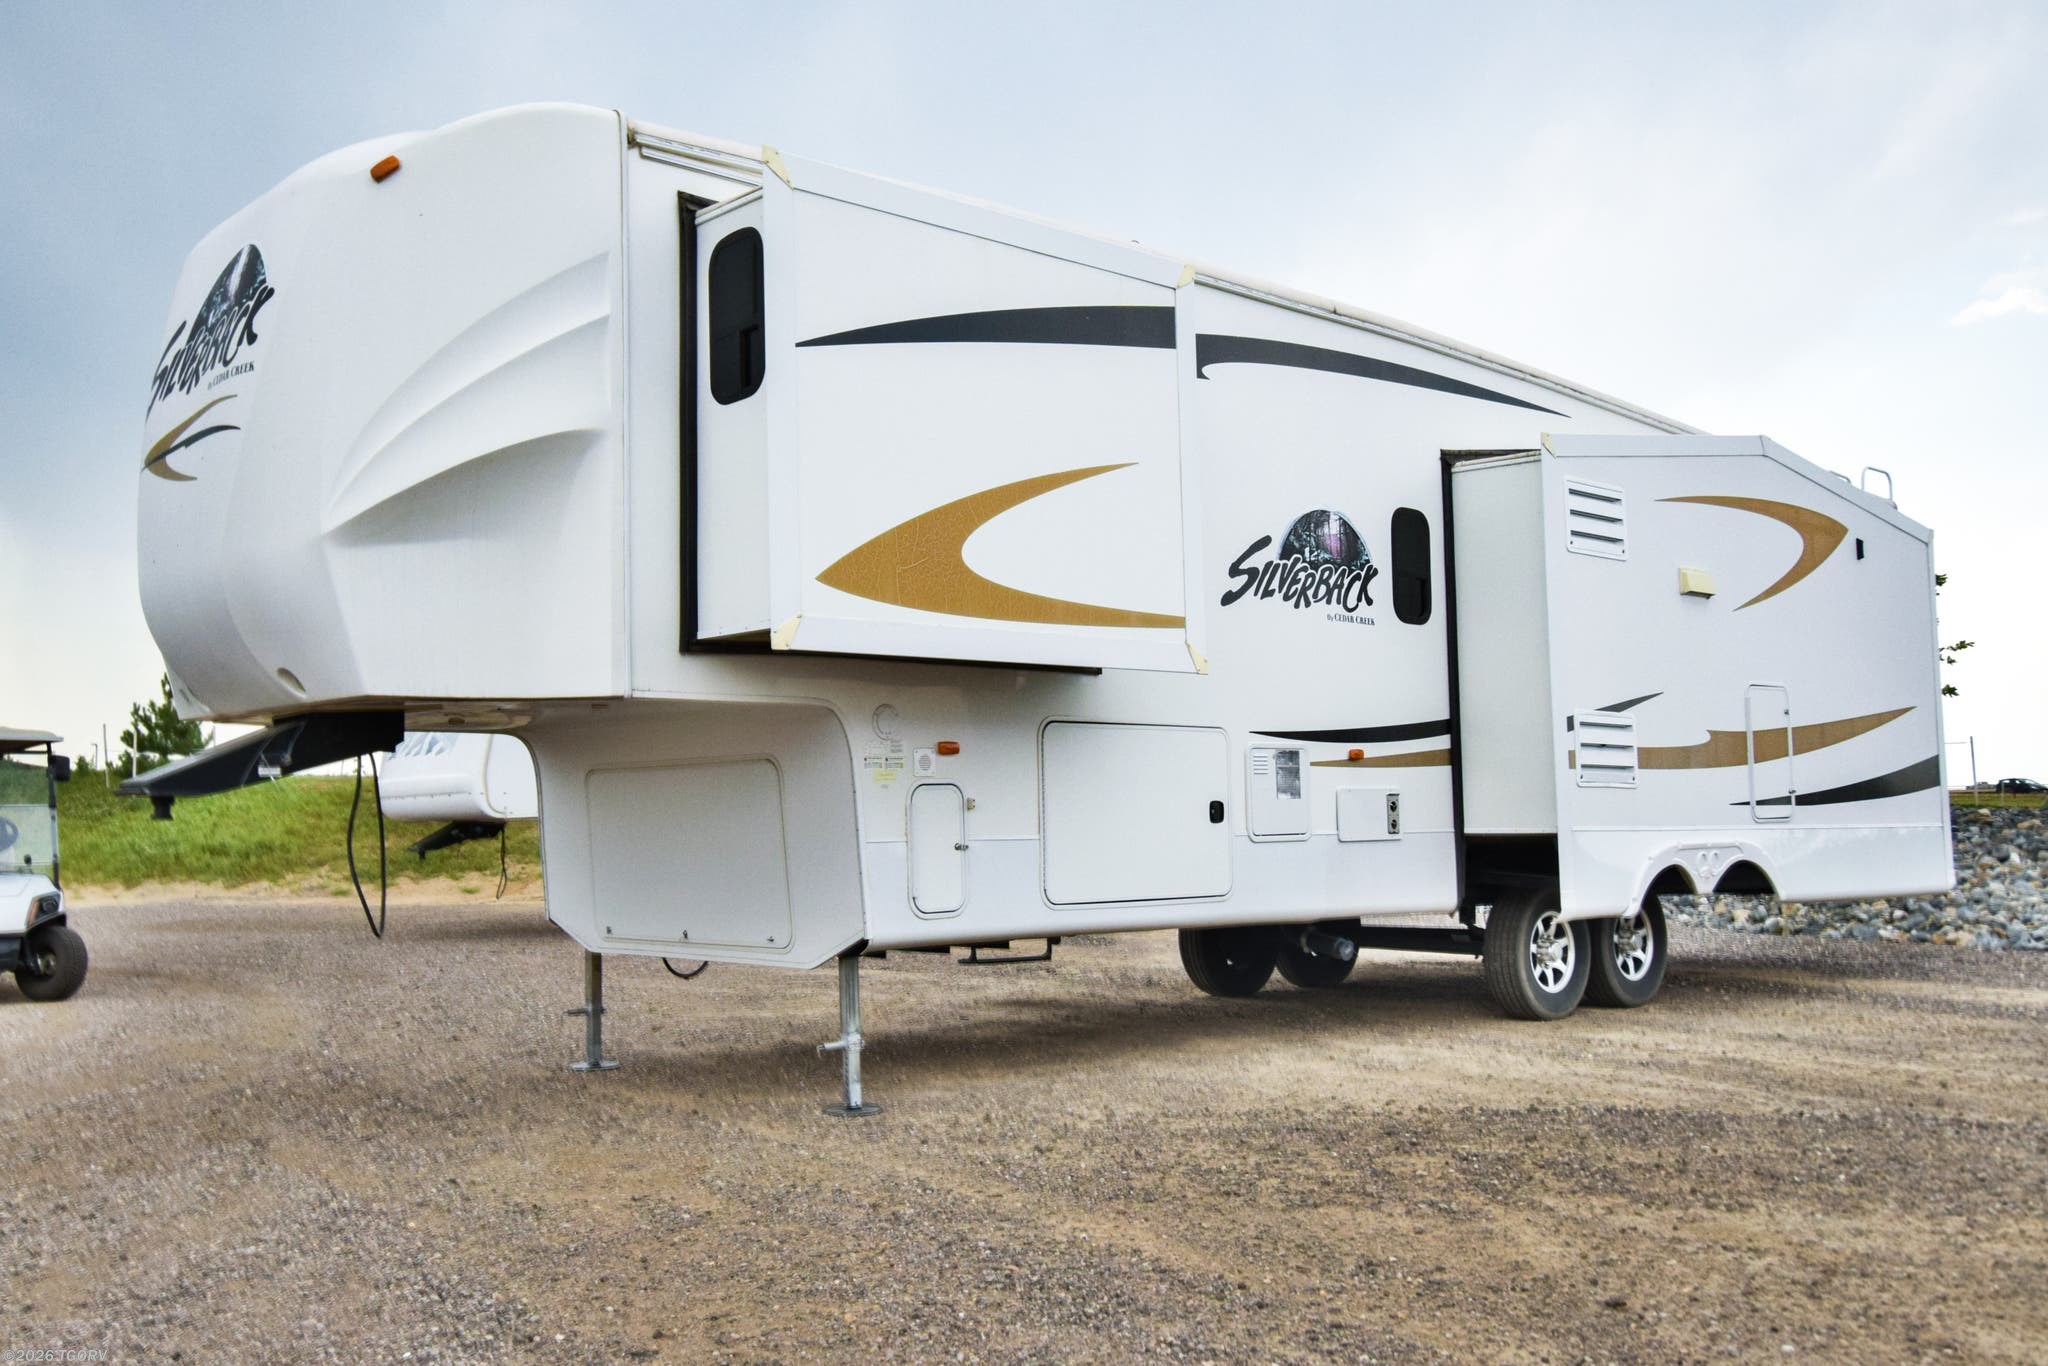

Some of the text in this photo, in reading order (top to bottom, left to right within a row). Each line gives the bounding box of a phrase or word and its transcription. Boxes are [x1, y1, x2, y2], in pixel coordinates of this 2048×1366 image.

[212, 369, 230, 387] CEDAR
[230, 360, 255, 377] CREEK
[1220, 535, 1379, 613] SILVERBACK
[1334, 613, 1355, 624] CEDAR
[1355, 615, 1376, 626] CREEK
